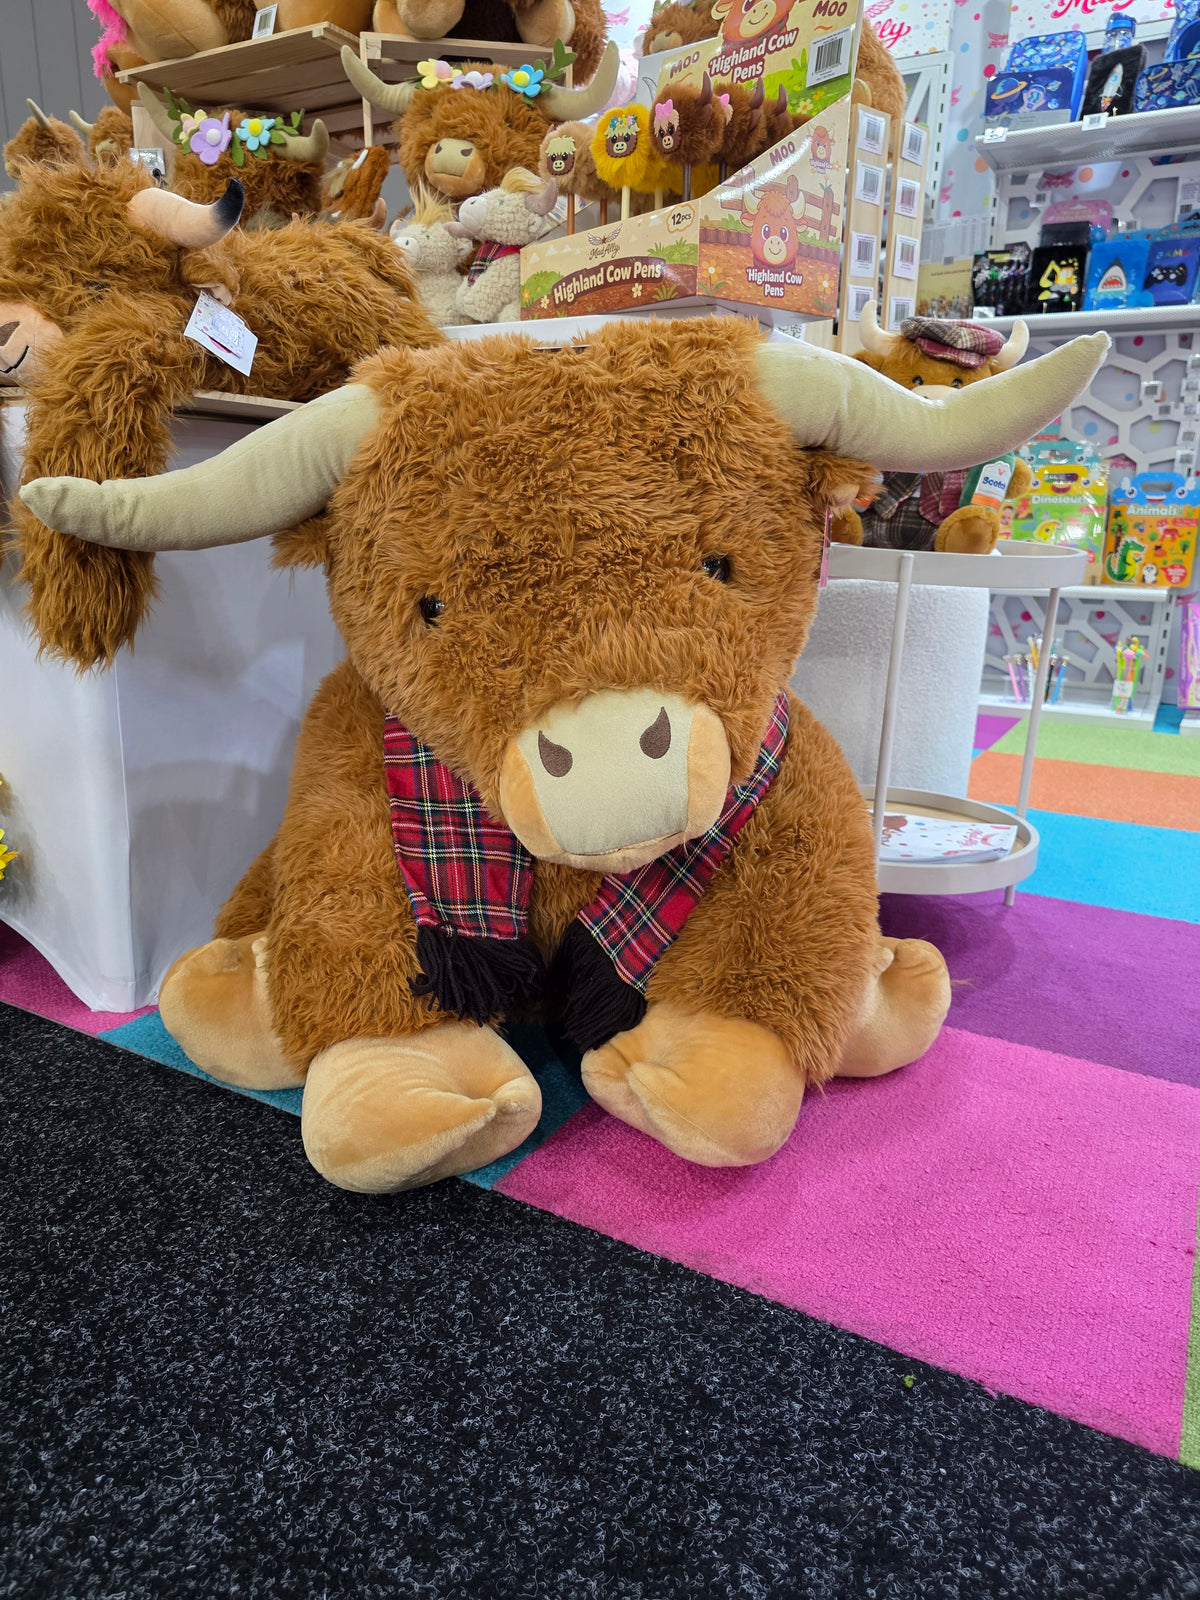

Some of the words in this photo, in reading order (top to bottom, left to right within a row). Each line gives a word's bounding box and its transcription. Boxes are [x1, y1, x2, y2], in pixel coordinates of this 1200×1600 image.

[709, 39, 766, 76] Highland
[767, 29, 798, 51] Cow
[733, 60, 764, 83] Pens
[553, 269, 605, 305] Highland
[606, 264, 632, 284] Cow
[633, 261, 662, 279] Pens
[746, 268, 785, 285] Highland
[785, 271, 803, 285] Cow
[764, 283, 785, 297] Pens
